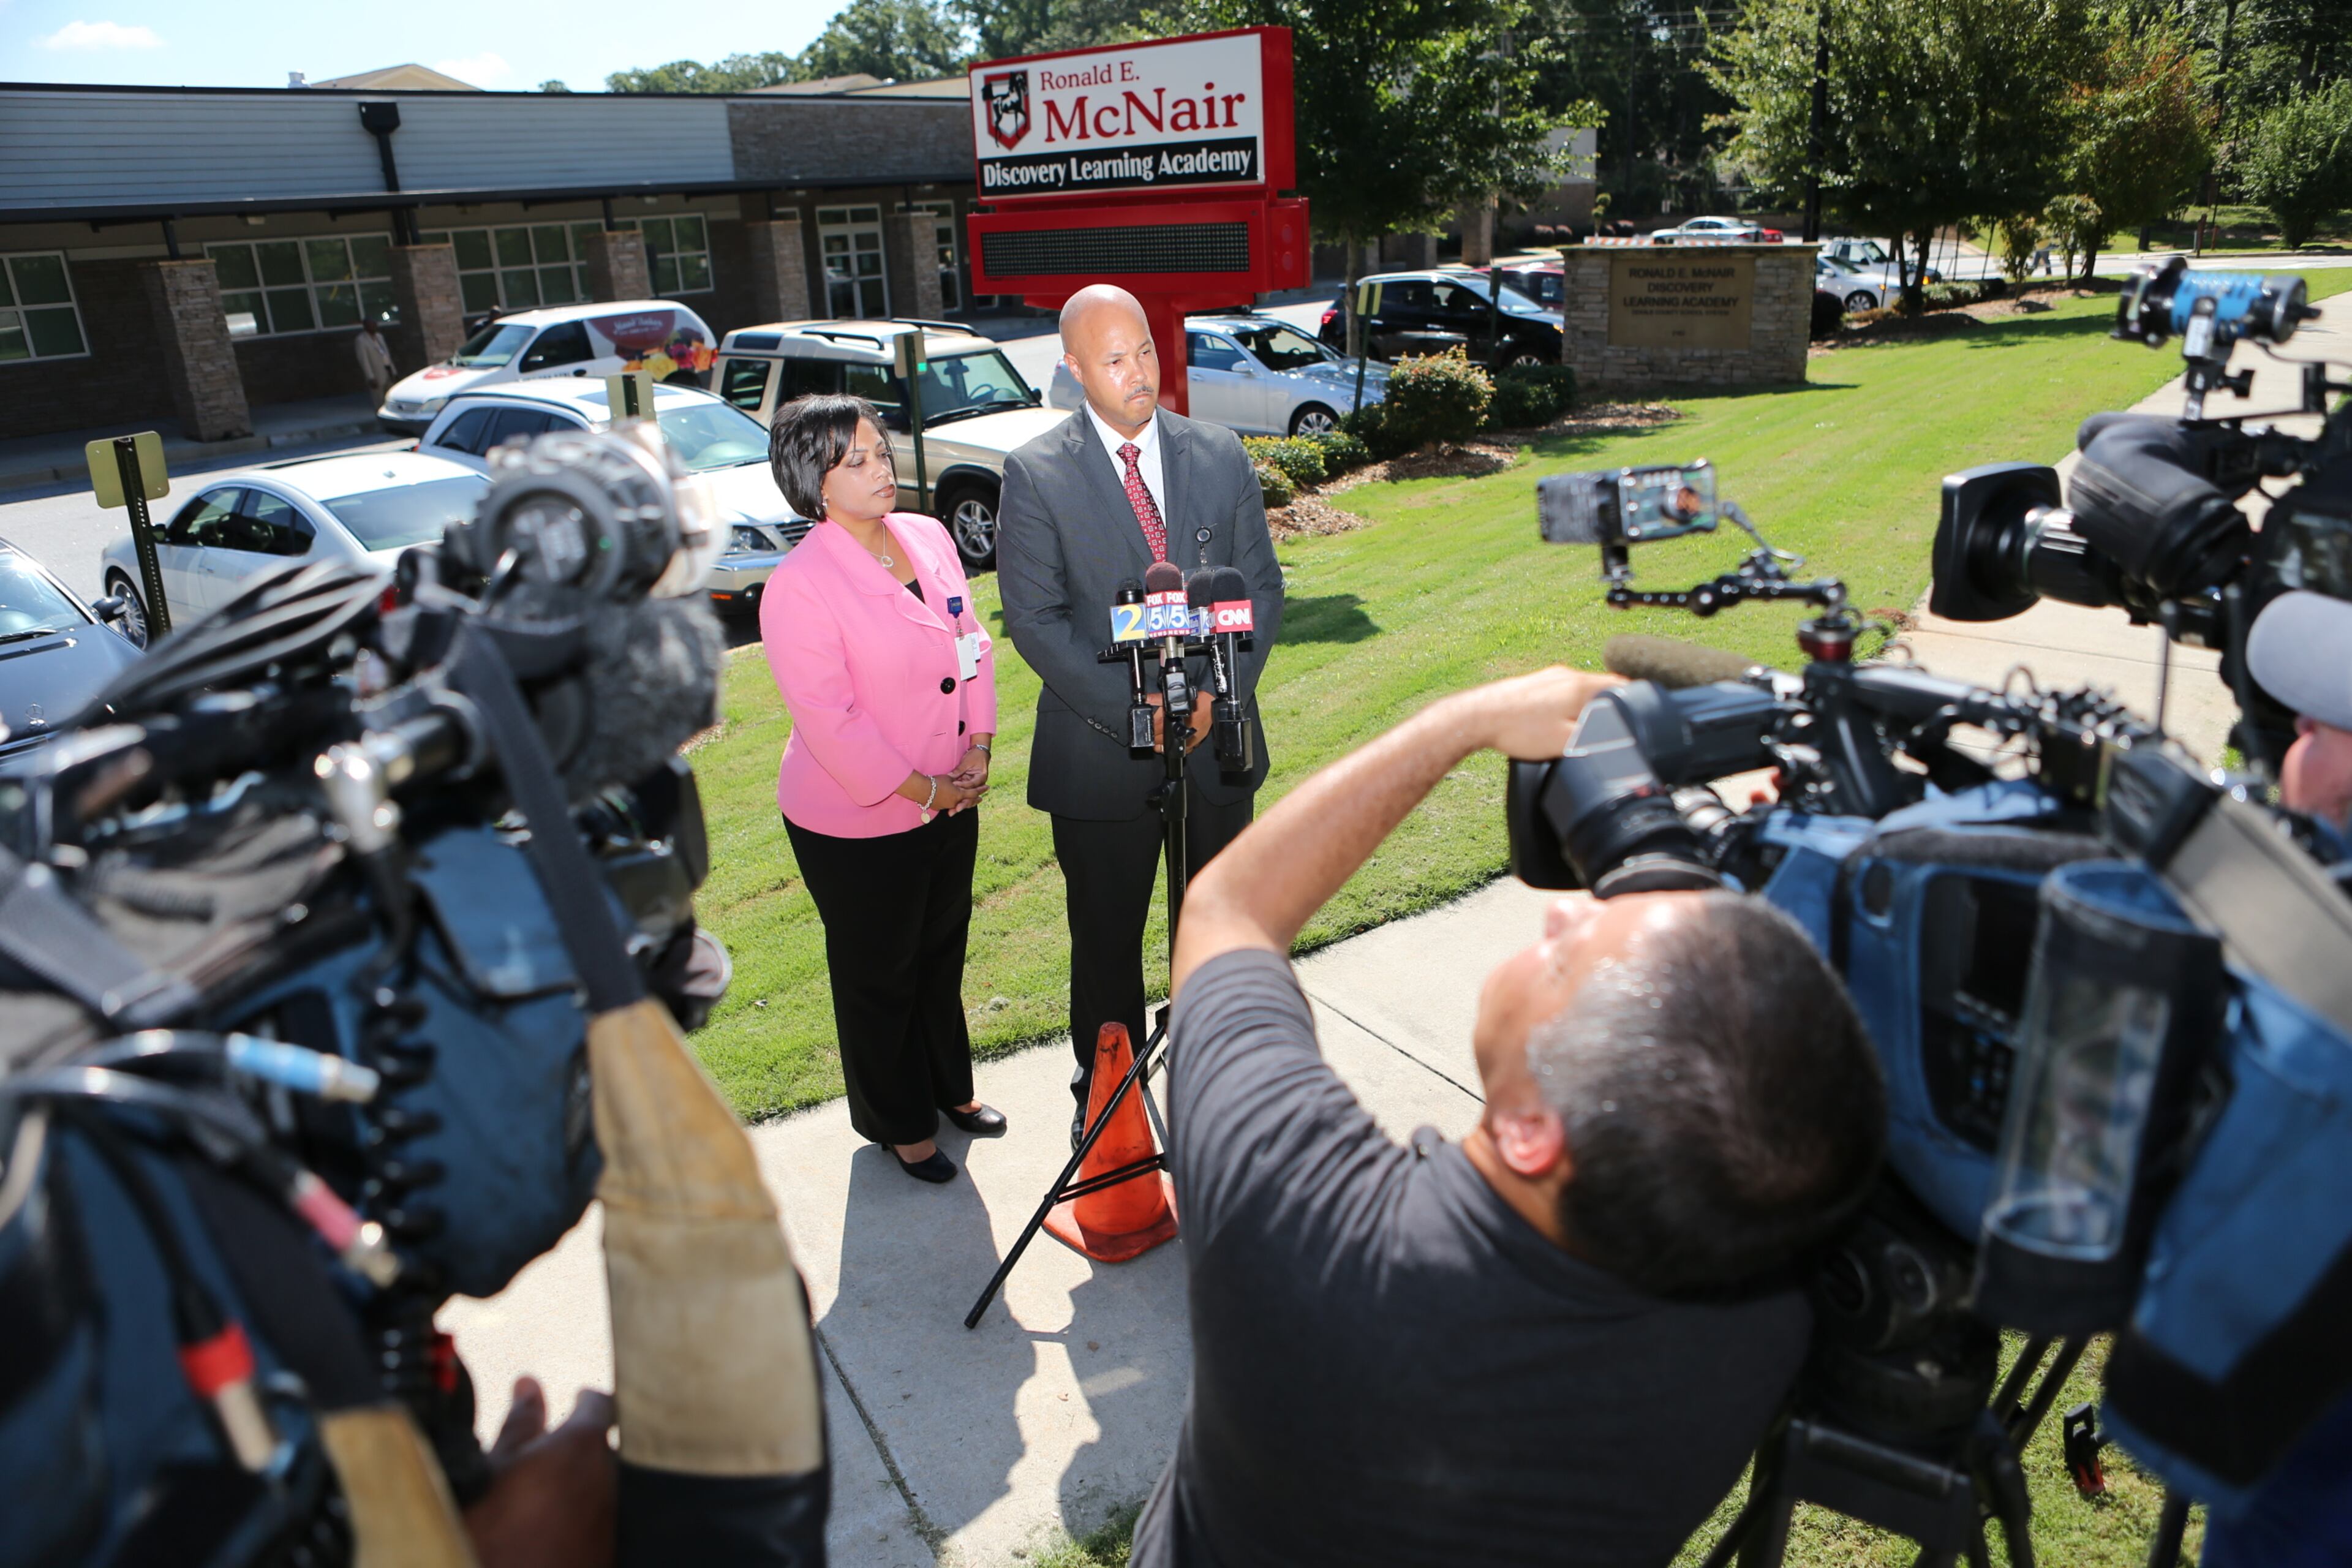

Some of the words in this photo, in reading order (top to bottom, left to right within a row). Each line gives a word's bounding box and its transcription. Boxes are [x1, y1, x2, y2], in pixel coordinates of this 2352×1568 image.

[1040, 64, 1112, 91] Ronald
[1120, 61, 1140, 81] E.
[1042, 82, 1246, 143] McNair
[982, 162, 1066, 187] Discovery
[1070, 151, 1155, 182] Learning
[1158, 147, 1251, 176] Academy
[1629, 268, 1675, 278] RONALD
[1692, 267, 1735, 278] McNAIR
[1648, 282, 1714, 293] DISCOVERY
[1623, 296, 1679, 307] LEARNING
[1681, 296, 1739, 307] ACADEMY
[1146, 593, 1163, 607] FOX
[1166, 592, 1186, 603] FOX
[1117, 603, 1145, 641] 2
[1152, 606, 1163, 630] 5
[1170, 604, 1186, 628] 5
[1218, 608, 1251, 626] CNN
